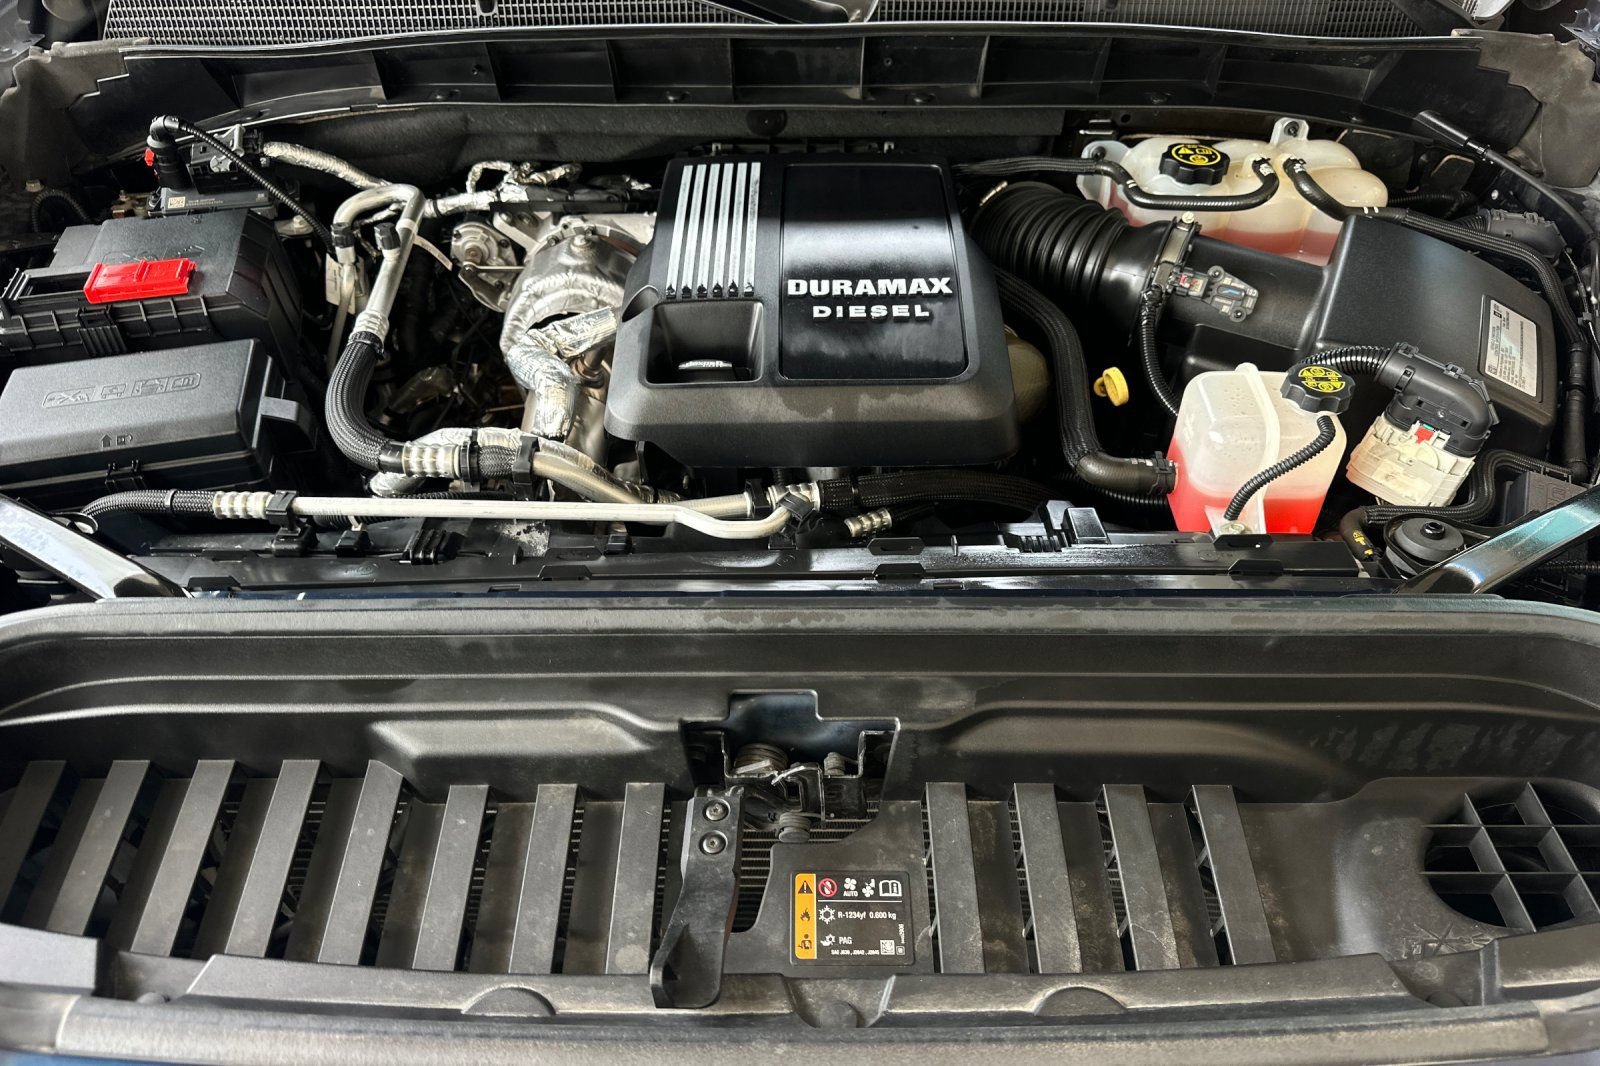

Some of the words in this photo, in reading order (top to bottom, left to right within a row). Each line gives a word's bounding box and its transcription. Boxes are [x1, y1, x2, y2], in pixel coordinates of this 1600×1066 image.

[787, 277, 953, 296] DURAMAX
[813, 305, 930, 317] DIESEL
[837, 911, 866, 920] R-1234yf
[888, 912, 896, 920] kg
[839, 937, 852, 945] PAG
